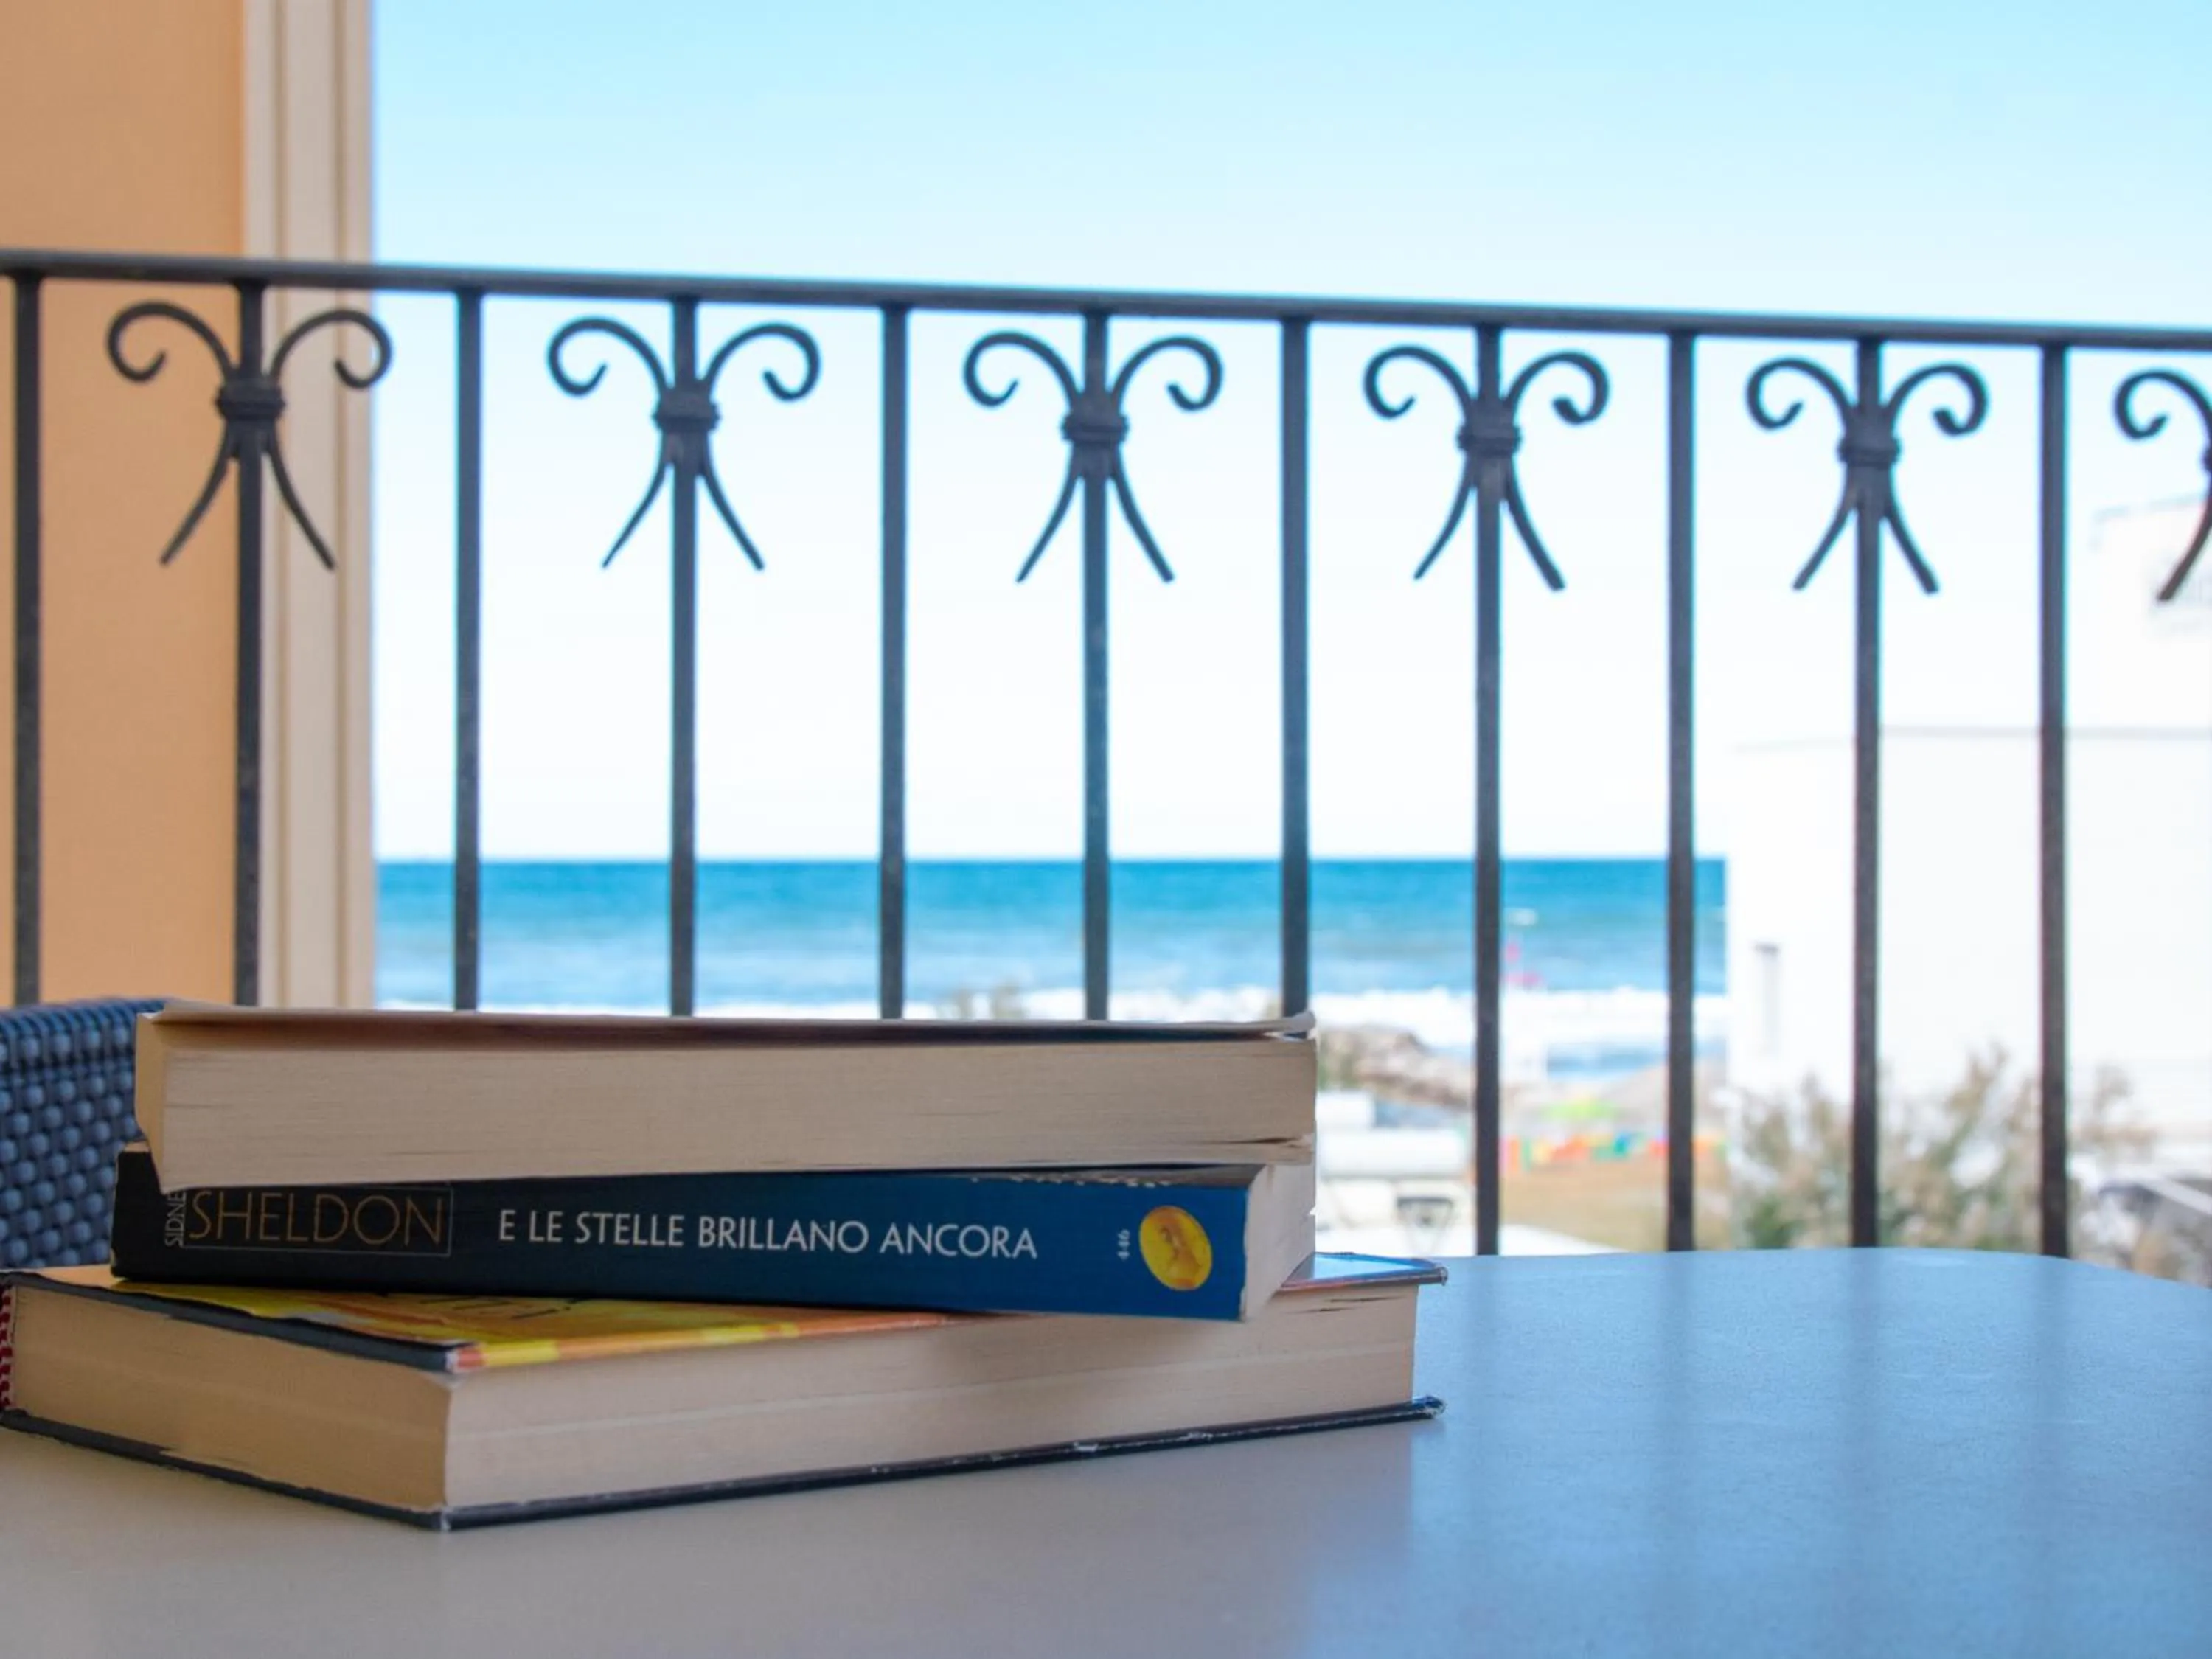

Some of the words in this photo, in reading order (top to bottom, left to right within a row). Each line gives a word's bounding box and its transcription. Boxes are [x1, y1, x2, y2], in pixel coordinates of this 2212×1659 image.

[164, 1191, 187, 1248] SIDNE
[188, 1188, 442, 1246] SHELDON
[498, 1209, 516, 1242] E
[528, 1211, 563, 1243] LE
[574, 1211, 685, 1247] STELLE
[697, 1216, 870, 1253] BRILLANO
[879, 1222, 1038, 1259] ANCORA
